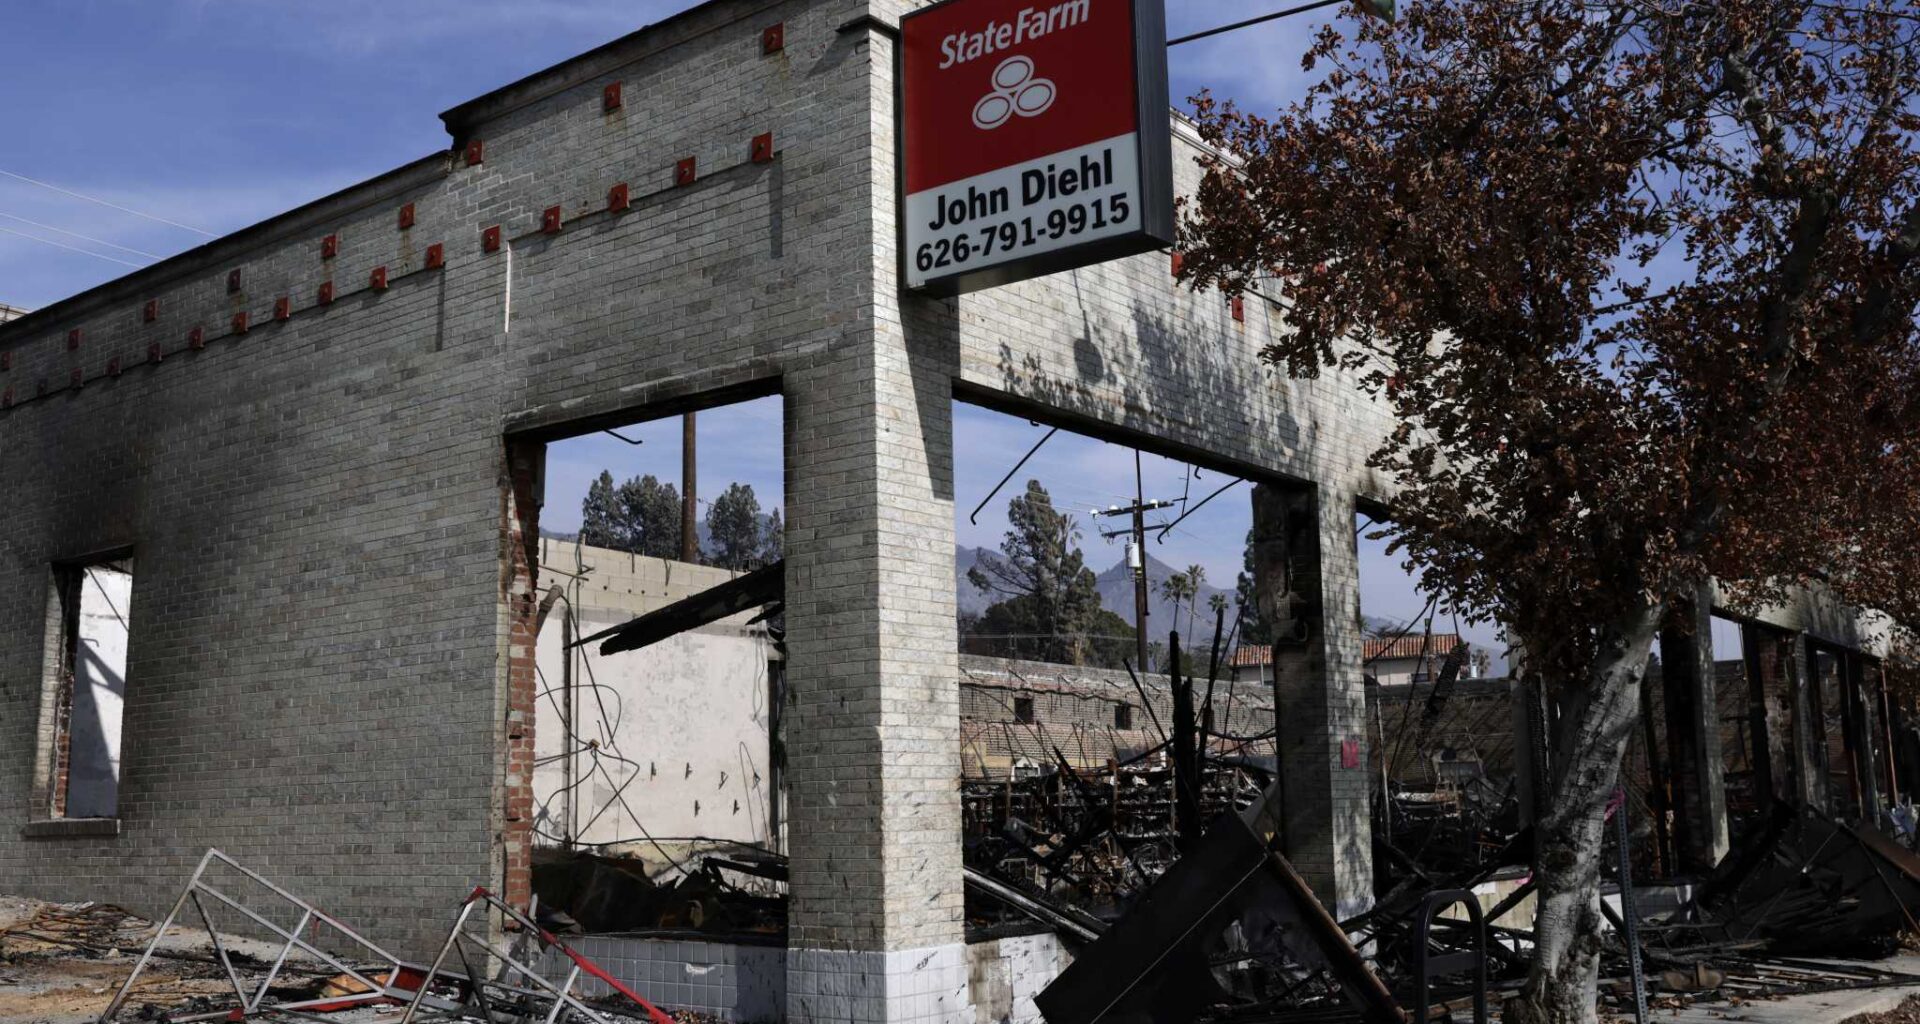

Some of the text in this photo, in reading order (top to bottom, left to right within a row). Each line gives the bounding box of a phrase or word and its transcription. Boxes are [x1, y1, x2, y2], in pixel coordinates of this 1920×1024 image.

[928, 148, 1113, 231] John Diehl
[916, 192, 1129, 272] 626-791-9915
